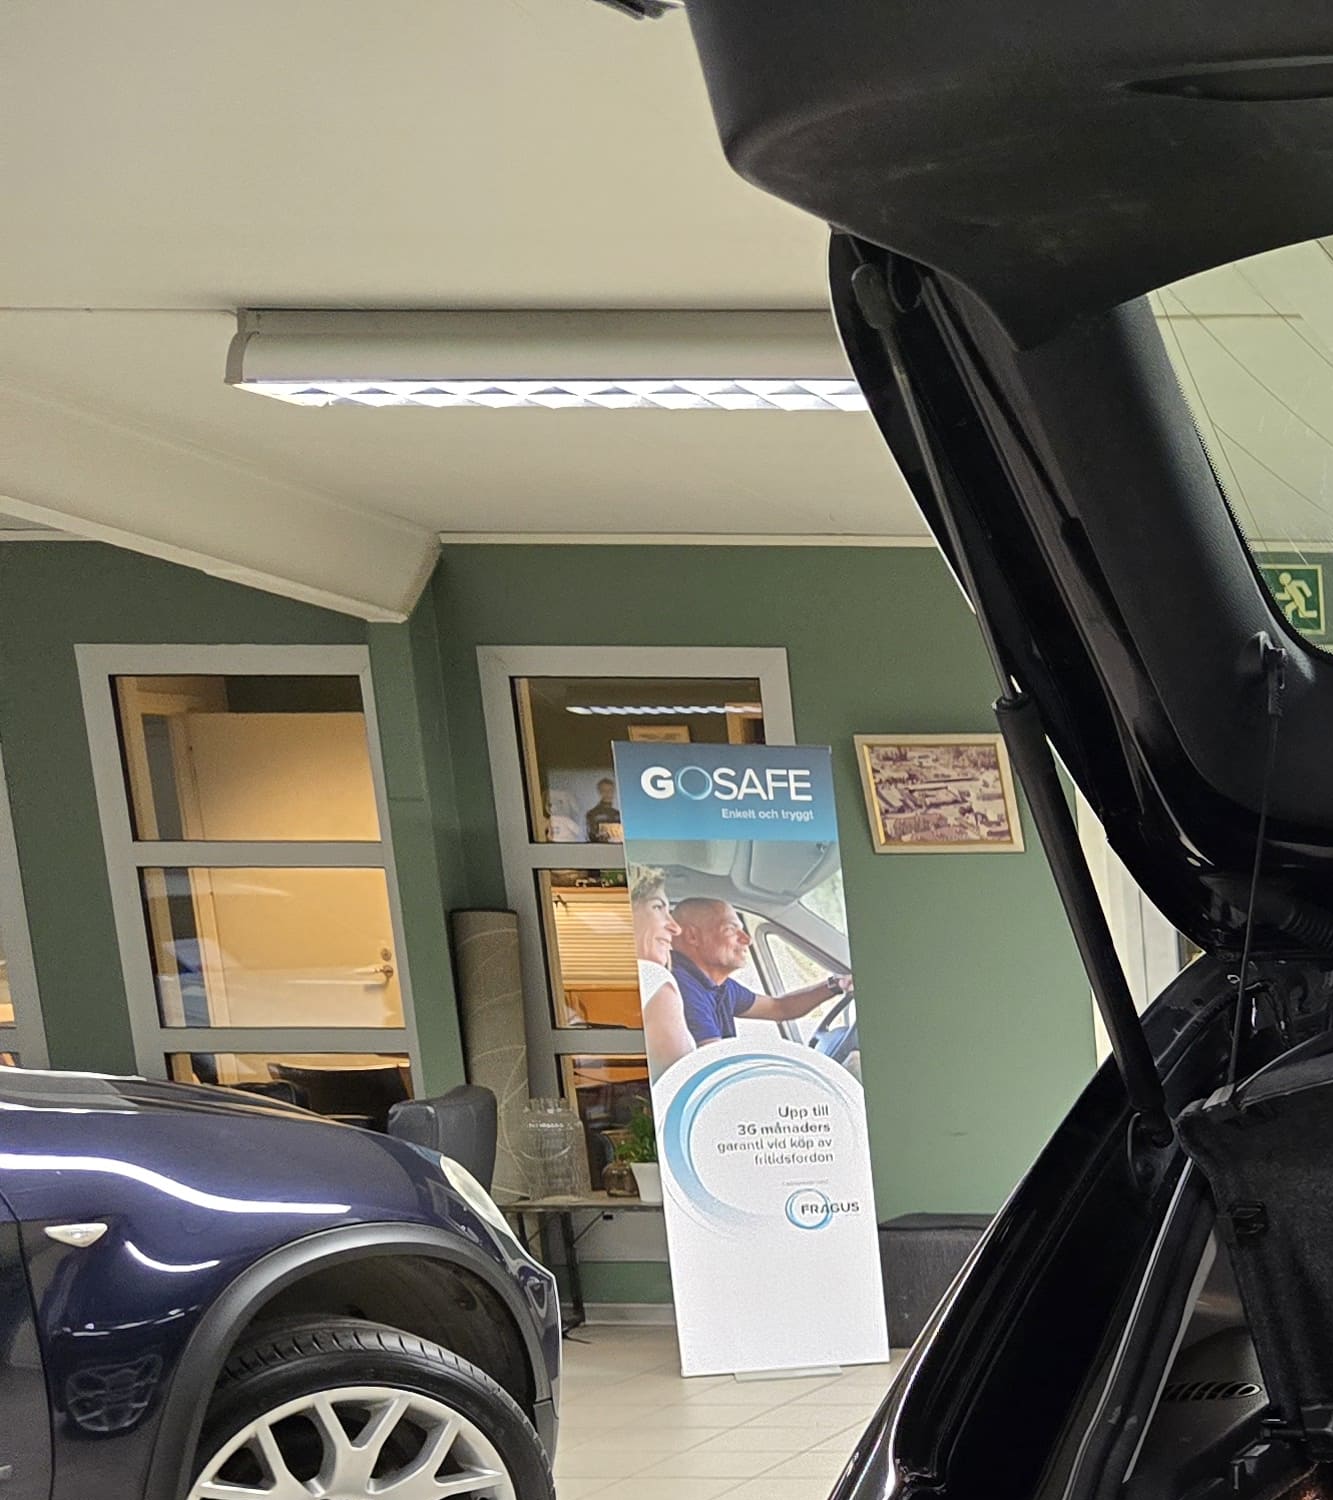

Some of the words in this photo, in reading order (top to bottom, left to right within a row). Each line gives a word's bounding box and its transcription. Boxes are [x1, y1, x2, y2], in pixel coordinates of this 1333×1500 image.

[640, 765, 813, 801] GOSAFE
[721, 808, 757, 820] Enkelt
[758, 808, 779, 820] och
[781, 808, 815, 822] tryggt
[778, 1105, 808, 1119] Upp
[813, 1104, 829, 1116] till
[760, 1121, 831, 1135] månaders
[717, 1138, 764, 1153] garanti
[767, 1137, 786, 1149] vid
[790, 1136, 814, 1150] köp
[817, 1138, 832, 1147] av
[754, 1152, 834, 1165] fritidsfordon
[800, 1201, 860, 1215] FRAGUS
